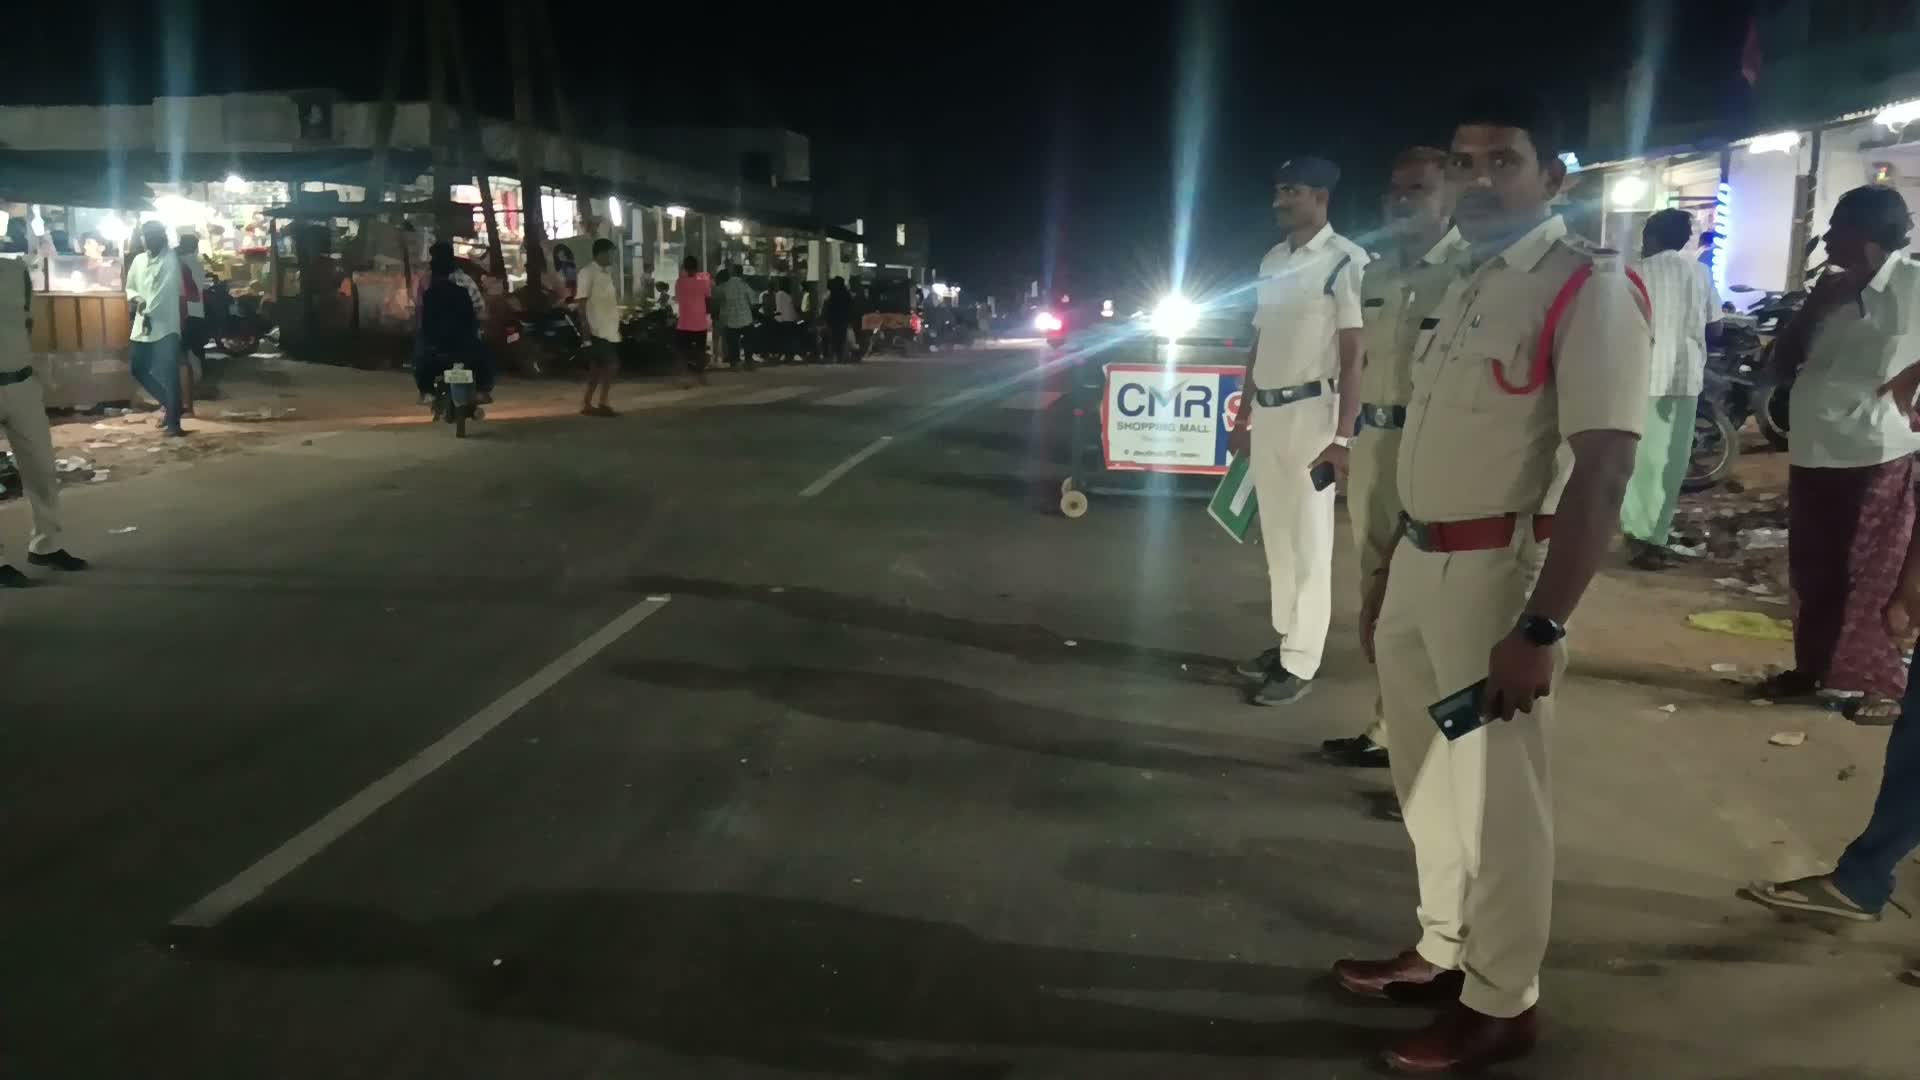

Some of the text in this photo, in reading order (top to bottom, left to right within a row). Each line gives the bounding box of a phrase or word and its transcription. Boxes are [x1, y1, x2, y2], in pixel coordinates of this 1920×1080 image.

[1117, 381, 1212, 418] CMR
[1117, 422, 1211, 433] SHOPPING MALL
